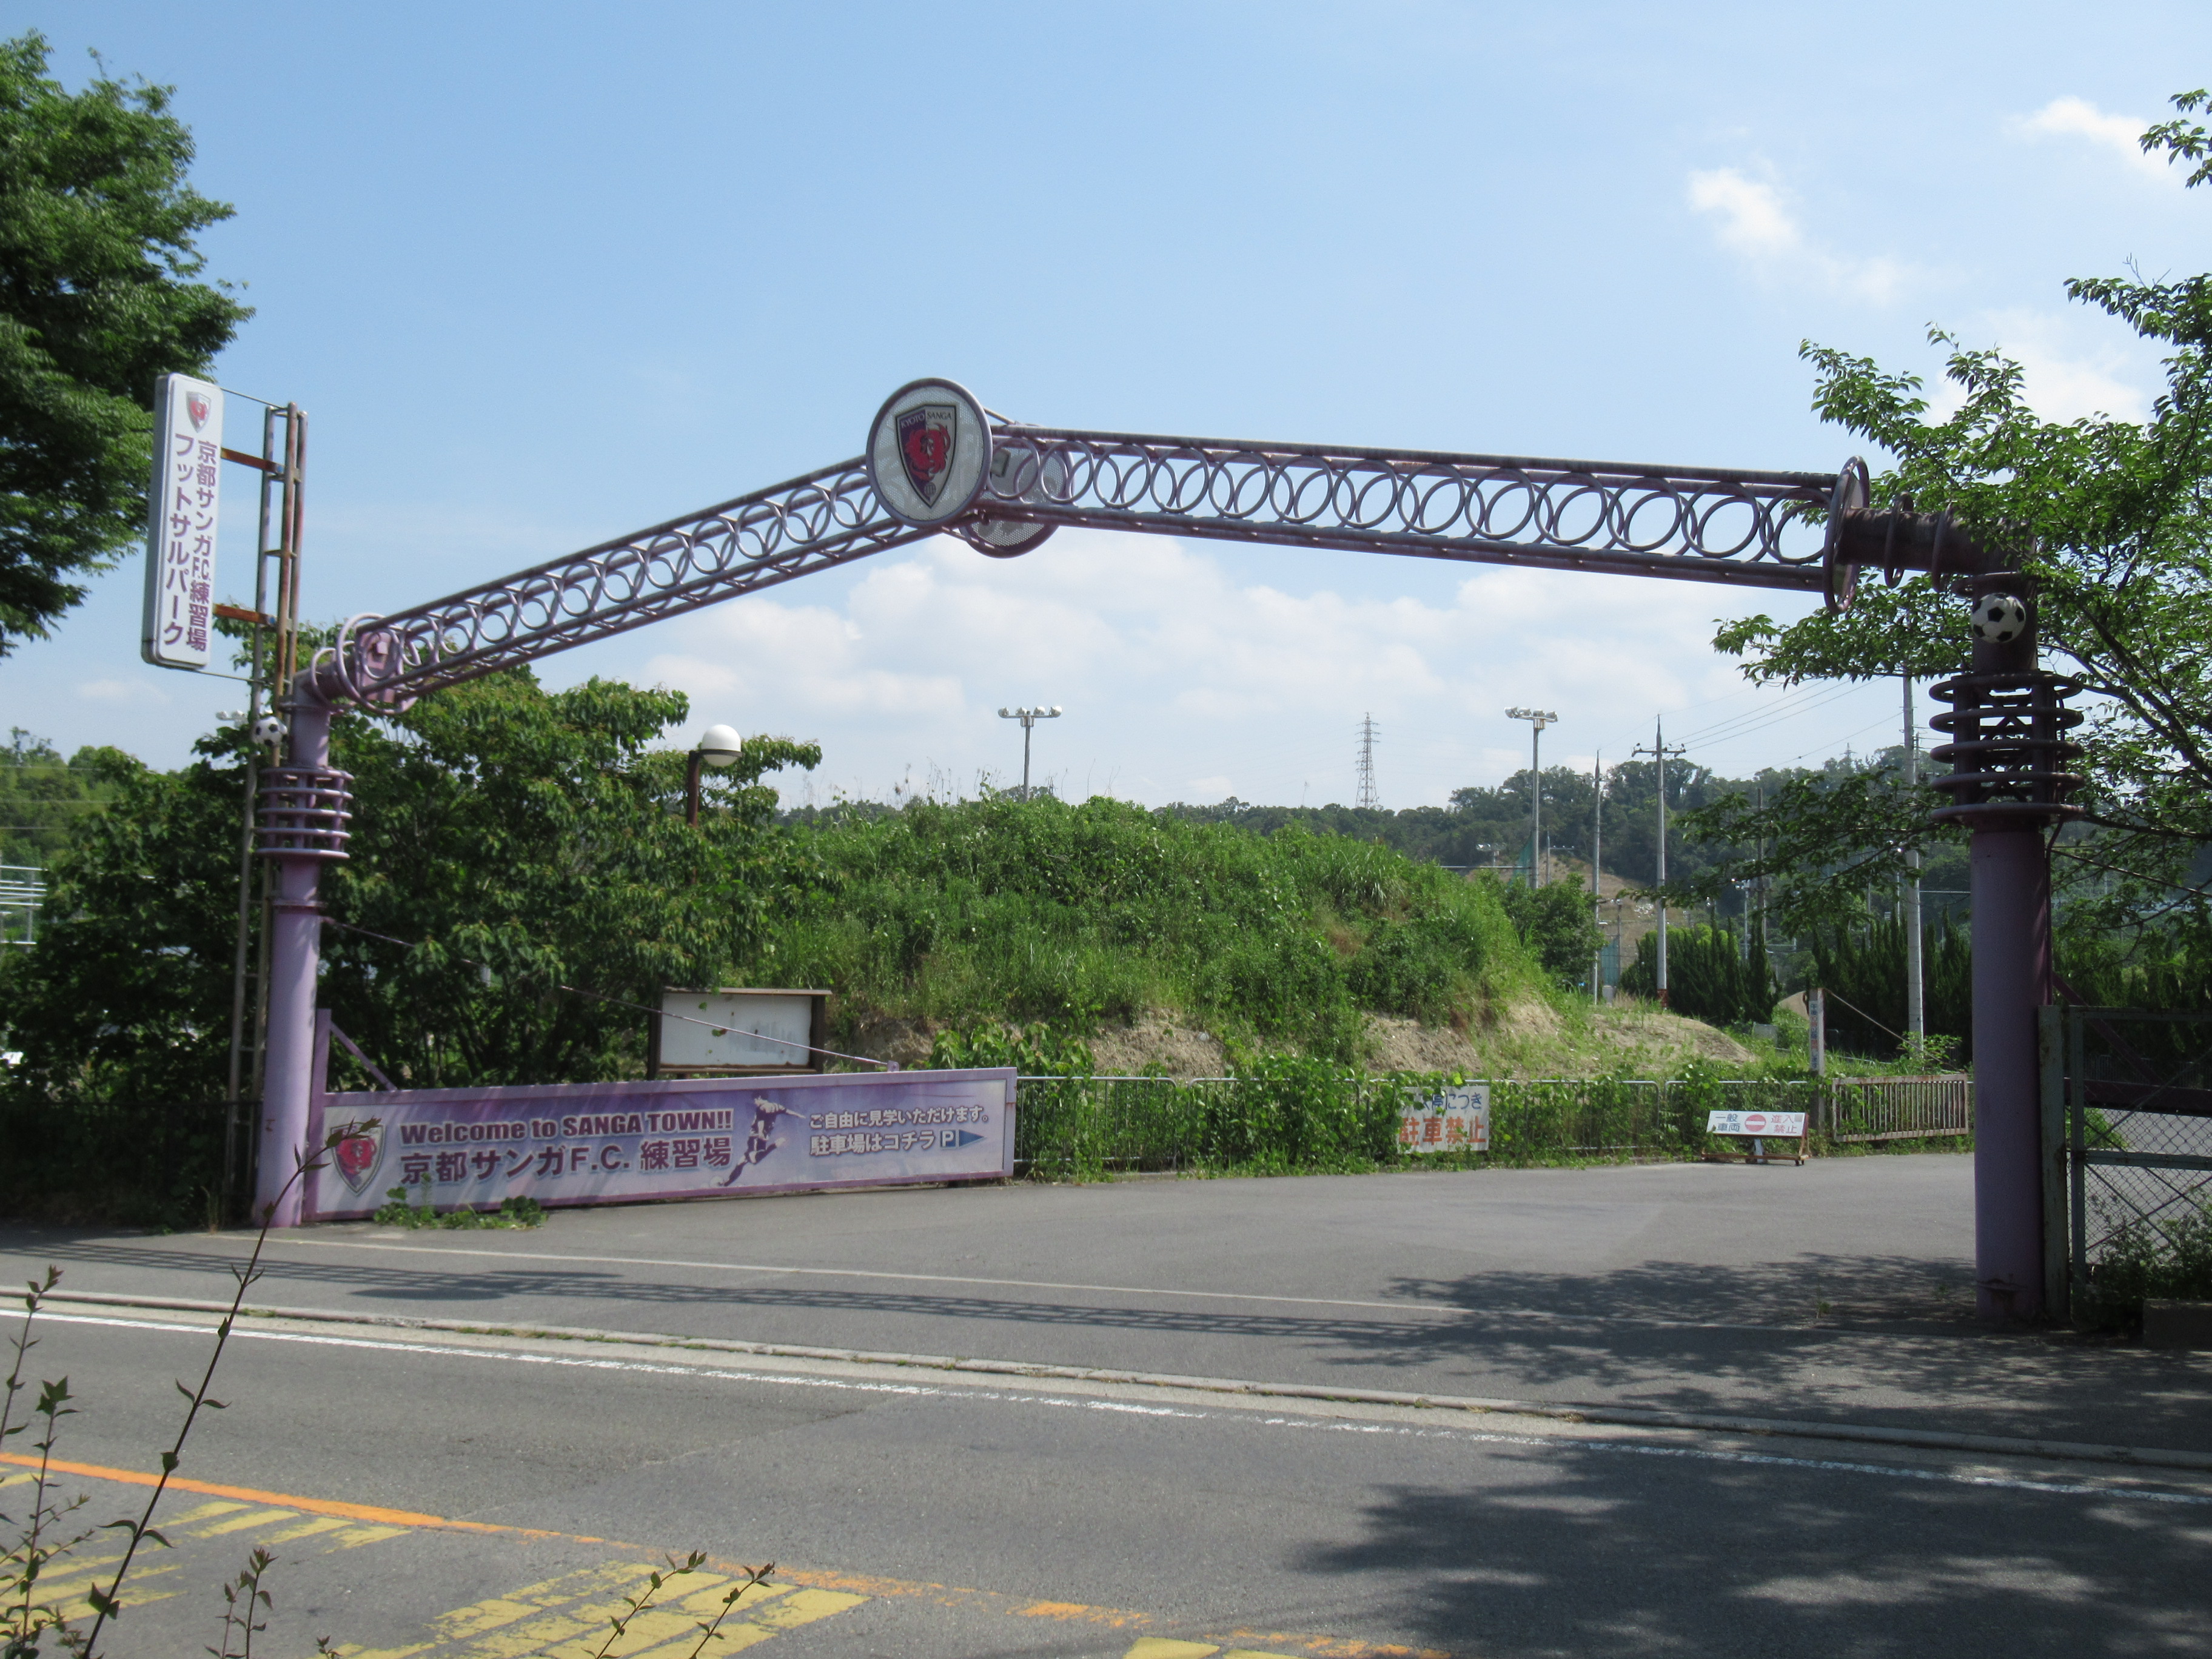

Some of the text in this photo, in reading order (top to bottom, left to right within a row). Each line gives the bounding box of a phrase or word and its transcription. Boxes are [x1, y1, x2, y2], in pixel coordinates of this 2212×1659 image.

[901, 413, 925, 428] KYOTO
[164, 433, 195, 646] フットサルパーク
[400, 1122, 526, 1145] Welcome
[532, 1120, 557, 1138] to
[562, 1114, 642, 1137] SANGA
[647, 1110, 732, 1132] TOWN!!
[809, 1105, 989, 1130] ご自由に見学いただけます。
[1715, 1113, 1738, 1122] 一般
[1717, 1123, 1740, 1132] 車両
[1771, 1114, 1794, 1124] 進入
[1399, 1116, 1487, 1146] 駐車禁止
[1774, 1124, 1797, 1134] 禁止
[809, 1131, 936, 1156] 駐車場はコチラ
